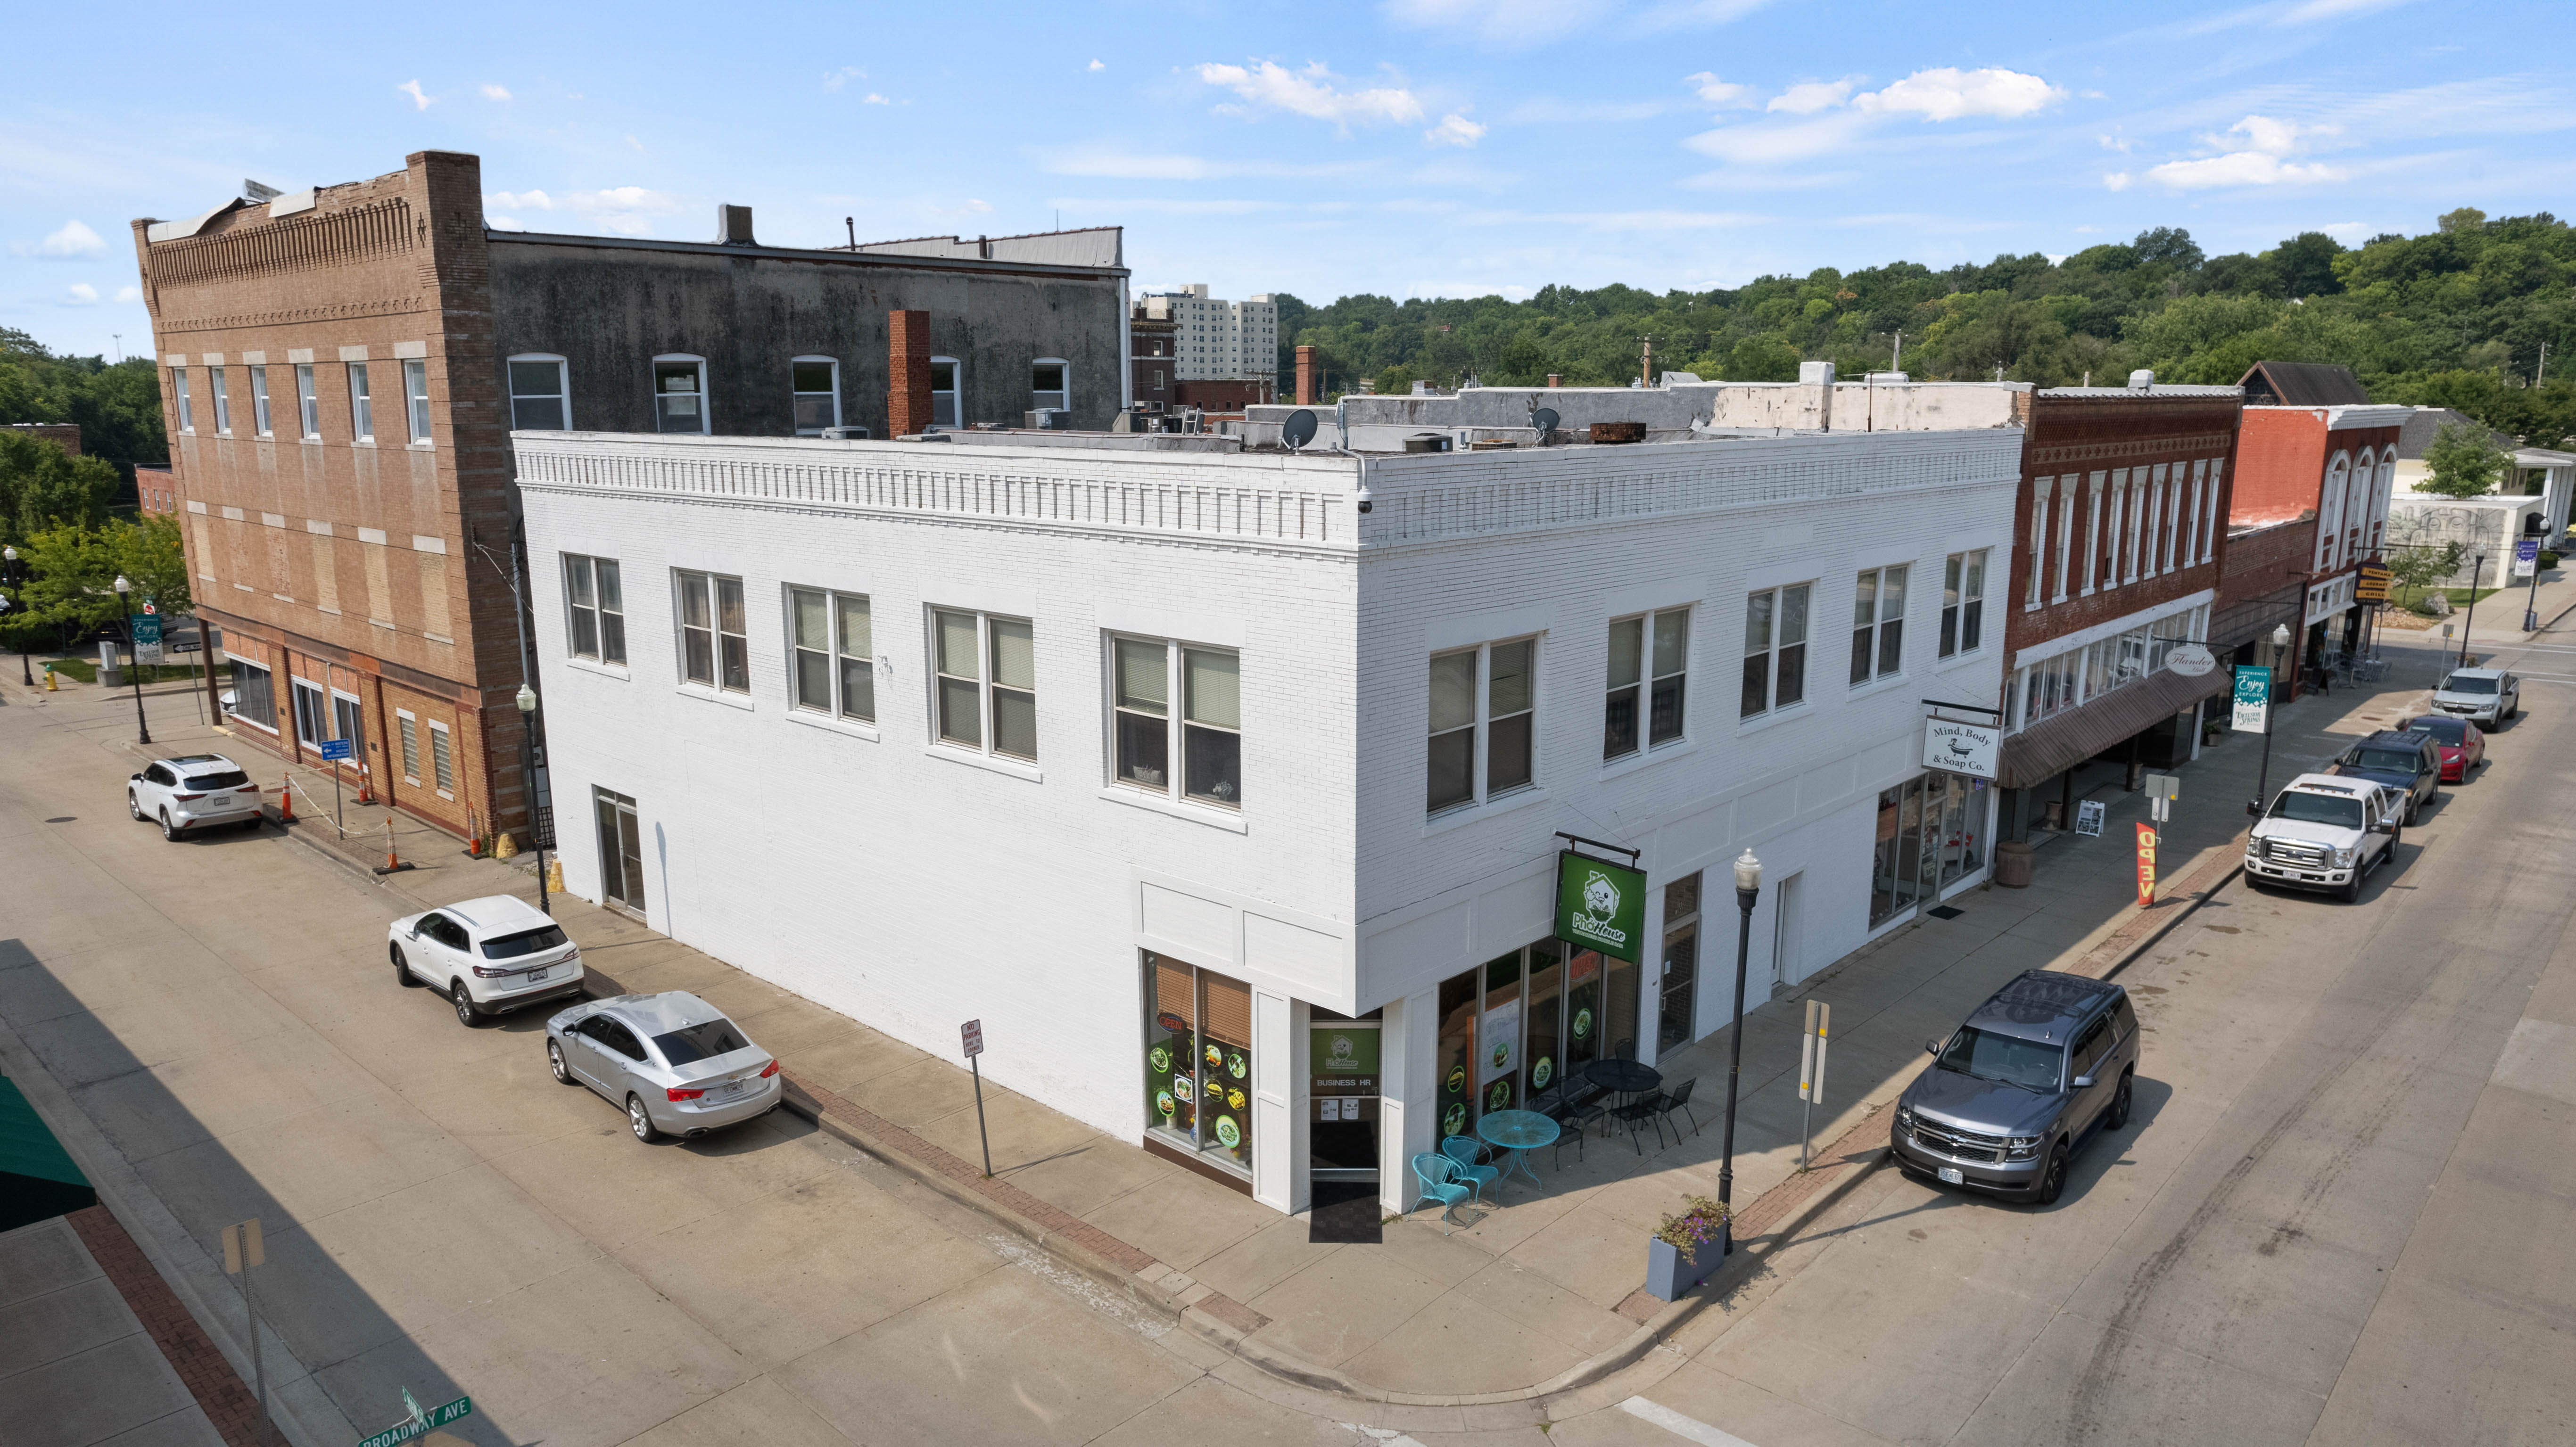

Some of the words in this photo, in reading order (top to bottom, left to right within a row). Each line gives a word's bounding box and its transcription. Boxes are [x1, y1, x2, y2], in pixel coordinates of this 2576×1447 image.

[132, 622, 157, 634] Enjoy
[2236, 675, 2265, 693] Enjoy
[1934, 727, 1963, 737] Mind,
[1966, 729, 1991, 747] Body
[1933, 755, 1941, 763] &
[1943, 756, 1966, 770] Soap
[1969, 761, 1984, 771] Co.
[967, 1023, 974, 1031] NO
[1159, 1016, 1182, 1030] OPEN
[963, 1029, 980, 1041] PARKING
[968, 1045, 980, 1053] CORNER
[445, 1400, 467, 1422] AVE
